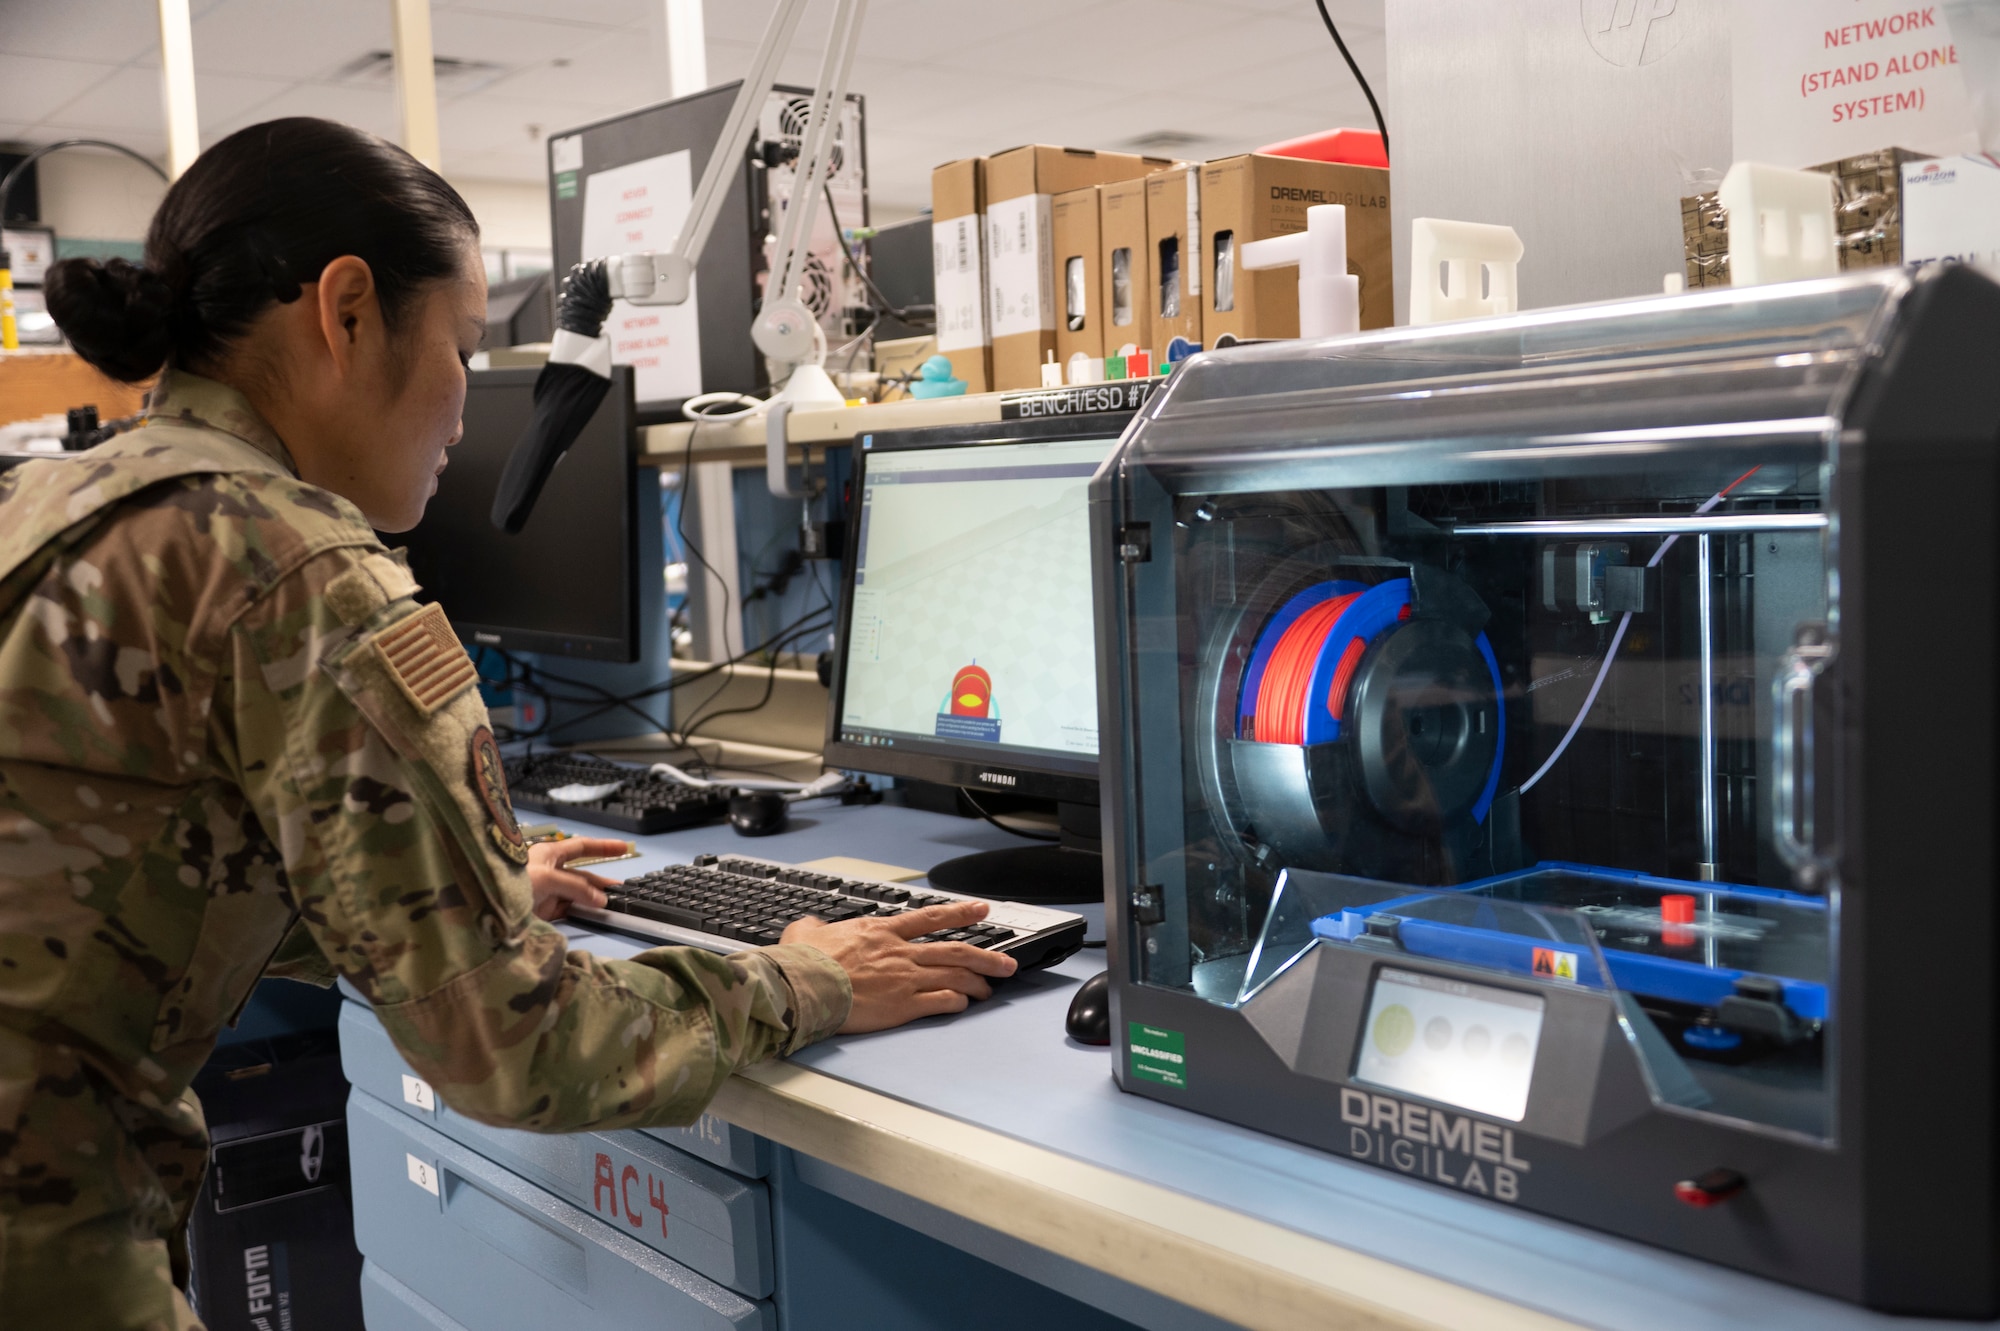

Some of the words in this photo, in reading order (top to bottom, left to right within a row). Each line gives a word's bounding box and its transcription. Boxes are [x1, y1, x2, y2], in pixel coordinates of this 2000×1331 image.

[1824, 6, 1935, 49] NETWORK
[1801, 62, 1879, 98] (STAND
[1832, 87, 1924, 123] SYSTEM)
[1907, 170, 1956, 184] HORIZON
[1271, 186, 1327, 203] DREMEL
[1019, 387, 1123, 417] BENCH/ESD
[1128, 384, 1150, 411] #7
[981, 772, 1016, 786] HYUNDAI
[1130, 1044, 1183, 1064] UNCLASSIFIED
[415, 1083, 422, 1103] 2
[1340, 1087, 1530, 1173] DREMEL
[419, 1165, 427, 1185] 3
[1351, 1127, 1519, 1201] DIGILAB
[593, 1152, 669, 1239] AC4
[244, 1244, 273, 1314] Form
